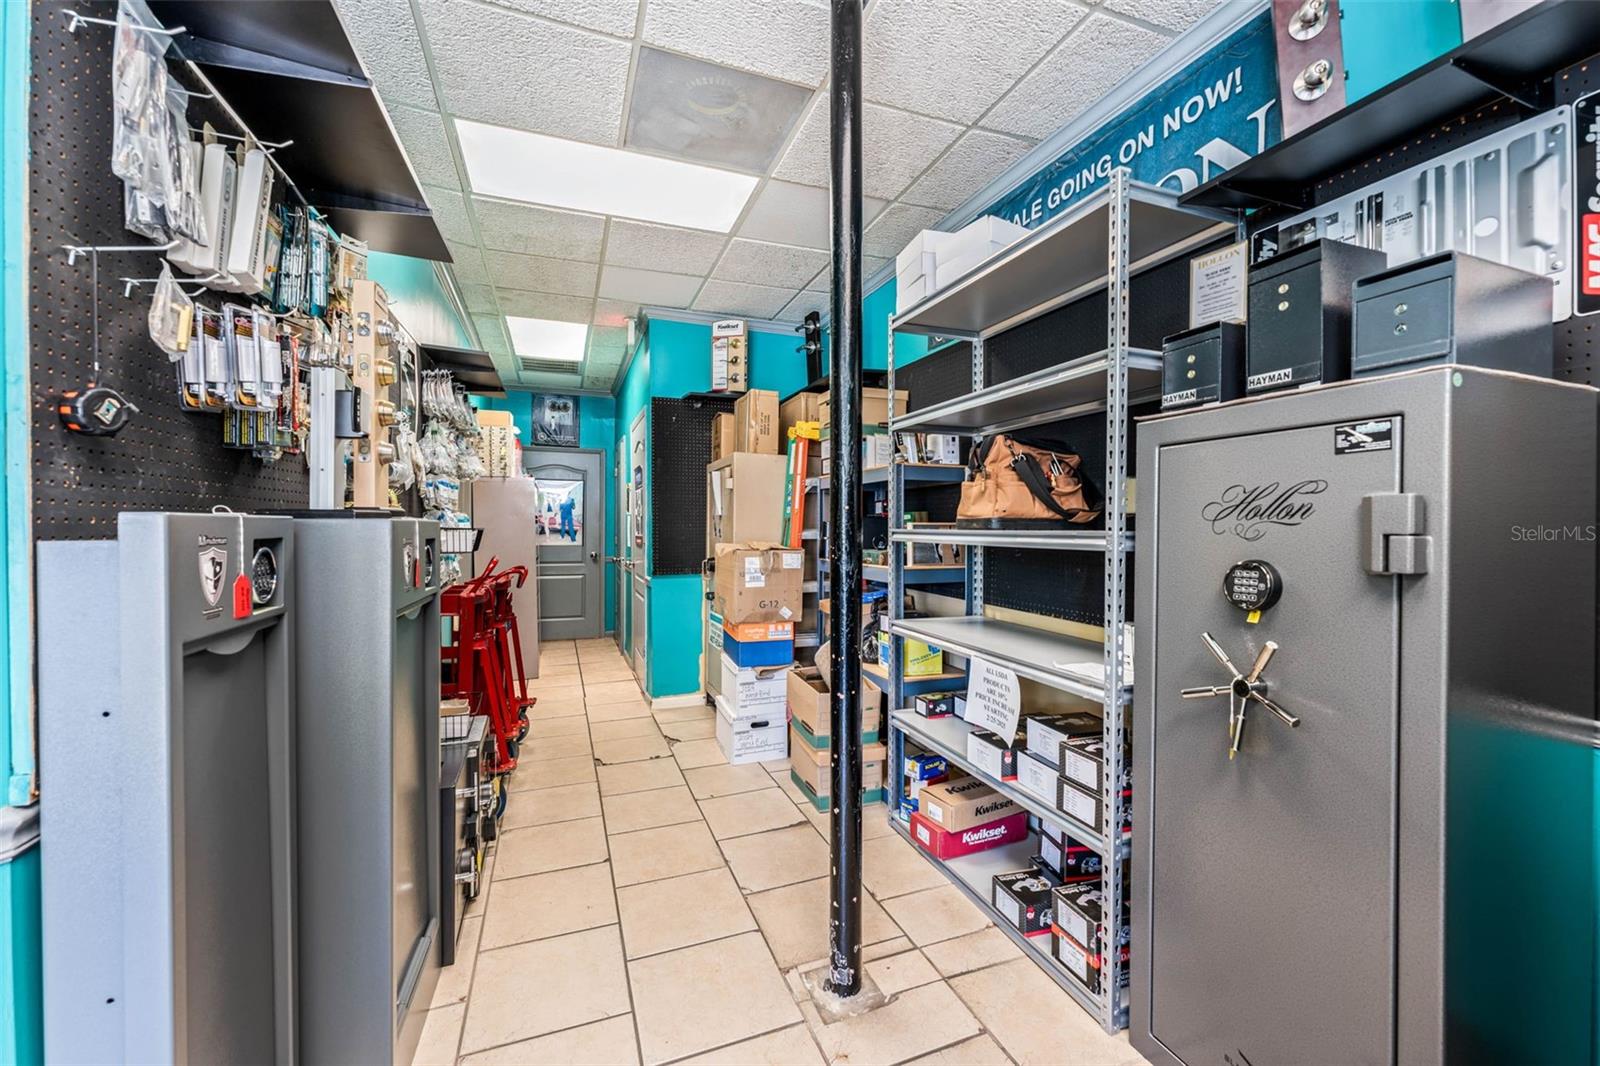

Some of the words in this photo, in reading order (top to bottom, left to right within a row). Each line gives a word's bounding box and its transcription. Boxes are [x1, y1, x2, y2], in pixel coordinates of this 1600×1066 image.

[1009, 199, 1042, 227] ALE
[1047, 155, 1111, 209] GOING
[1119, 124, 1155, 164] ON
[1163, 66, 1243, 139] NOW!
[1249, 370, 1291, 388] HAYMAN
[1163, 391, 1196, 404] HAYMAN
[1202, 480, 1328, 541] Hollon
[759, 600, 779, 609] G-12
[983, 677, 1011, 693] PRODUCTS
[975, 800, 1014, 817] Kwikset
[962, 825, 1006, 844] Kwikset
